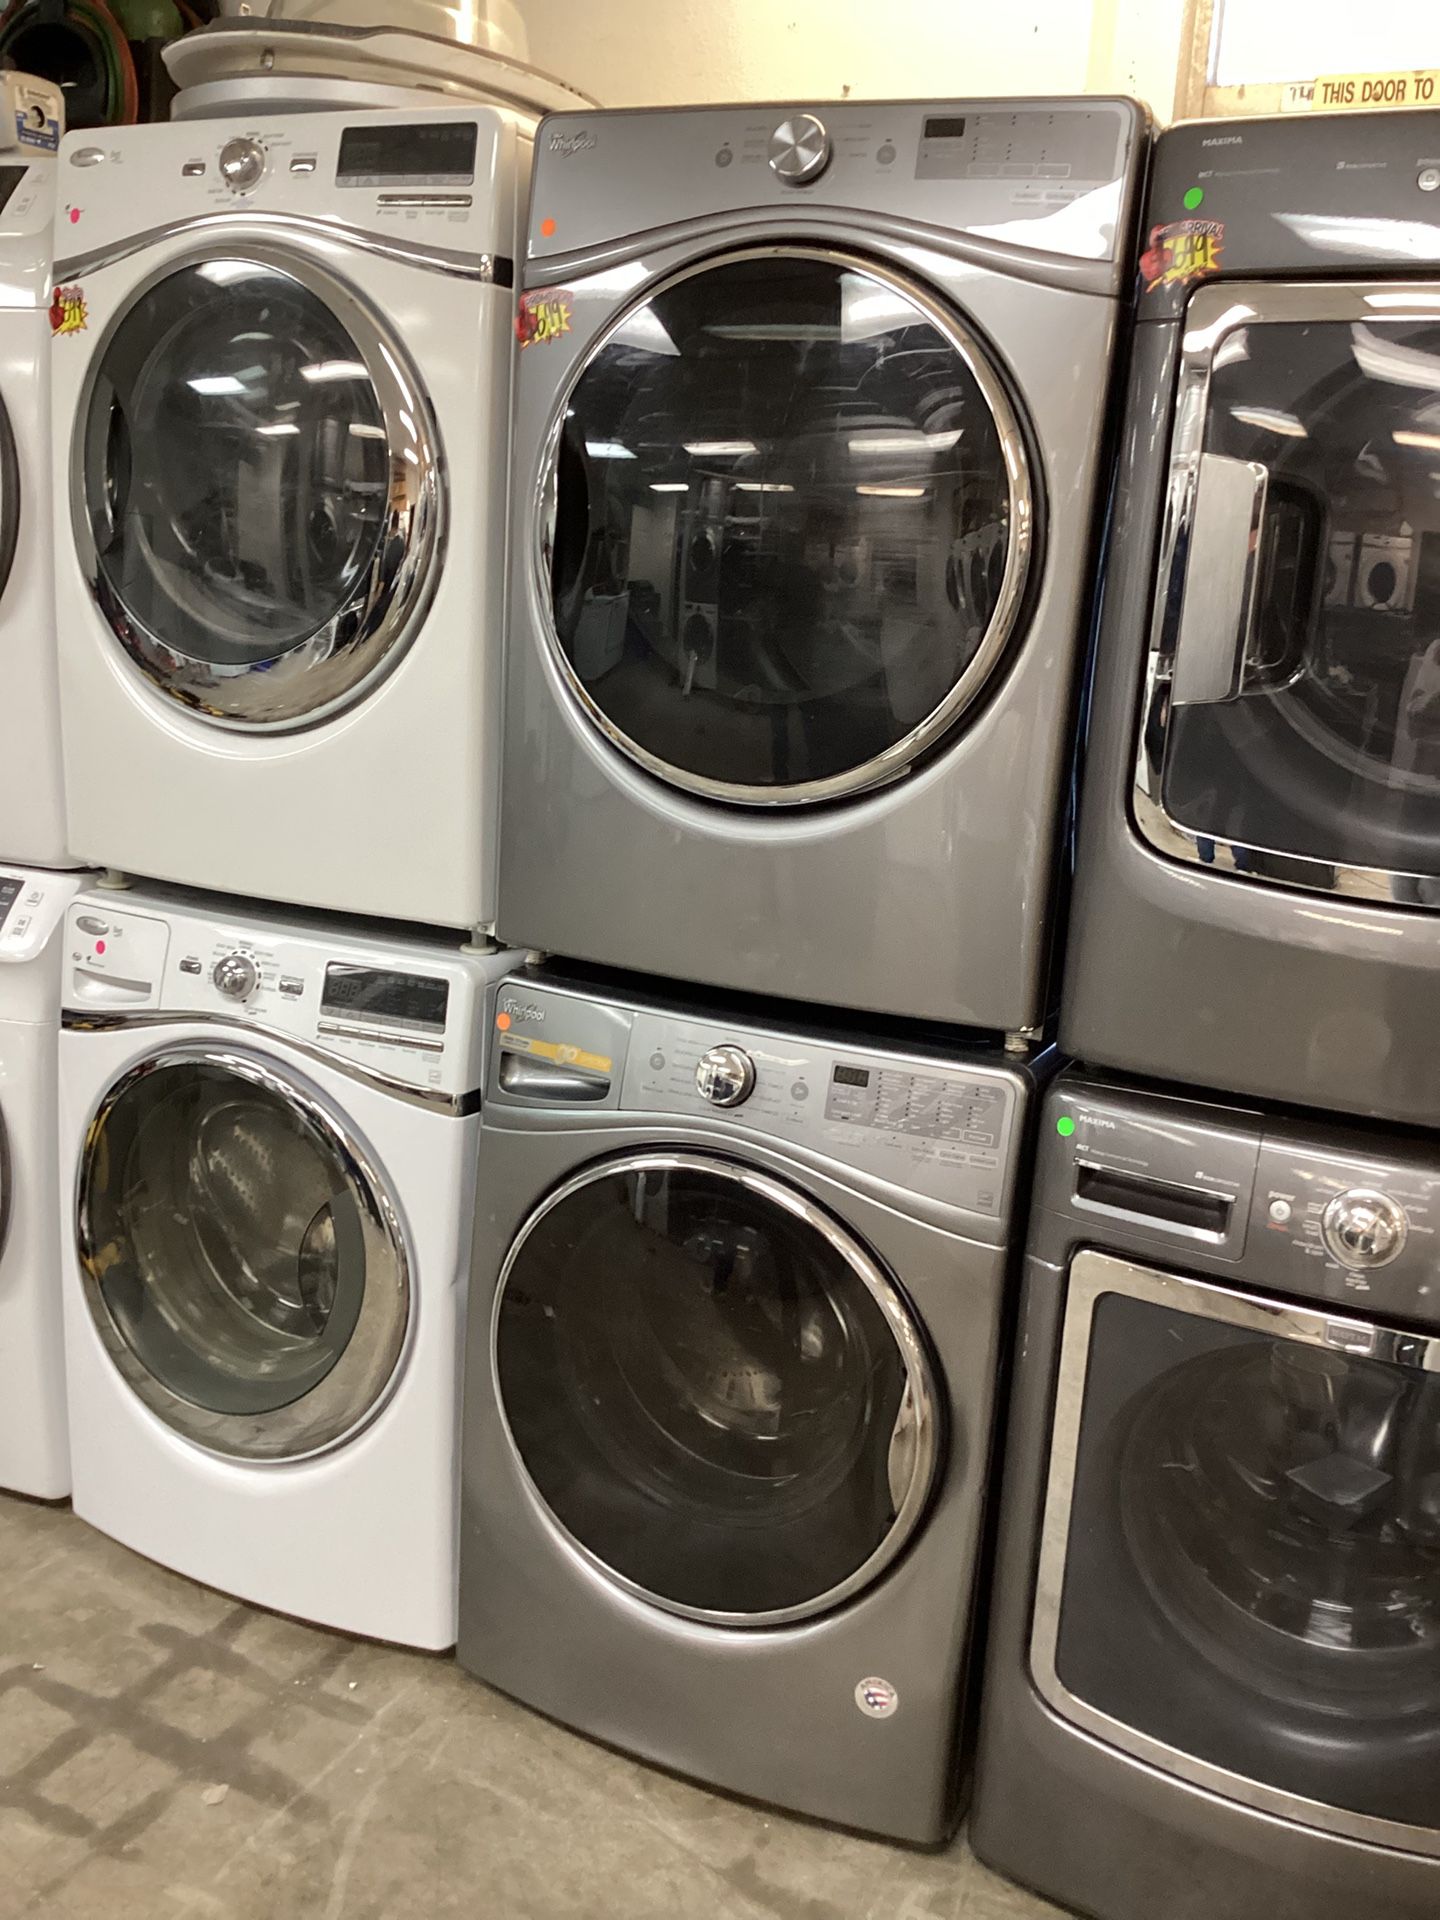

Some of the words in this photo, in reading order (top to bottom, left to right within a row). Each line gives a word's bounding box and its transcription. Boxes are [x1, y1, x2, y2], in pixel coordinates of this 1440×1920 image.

[1322, 81, 1355, 104] THIS
[1361, 79, 1407, 102] DOOR
[1414, 77, 1434, 100] TO
[549, 130, 598, 160] Whirlpool
[1202, 135, 1243, 147] MAXIMA
[502, 998, 546, 1024] Whirlpool
[1079, 1114, 1116, 1130] MAXIMA
